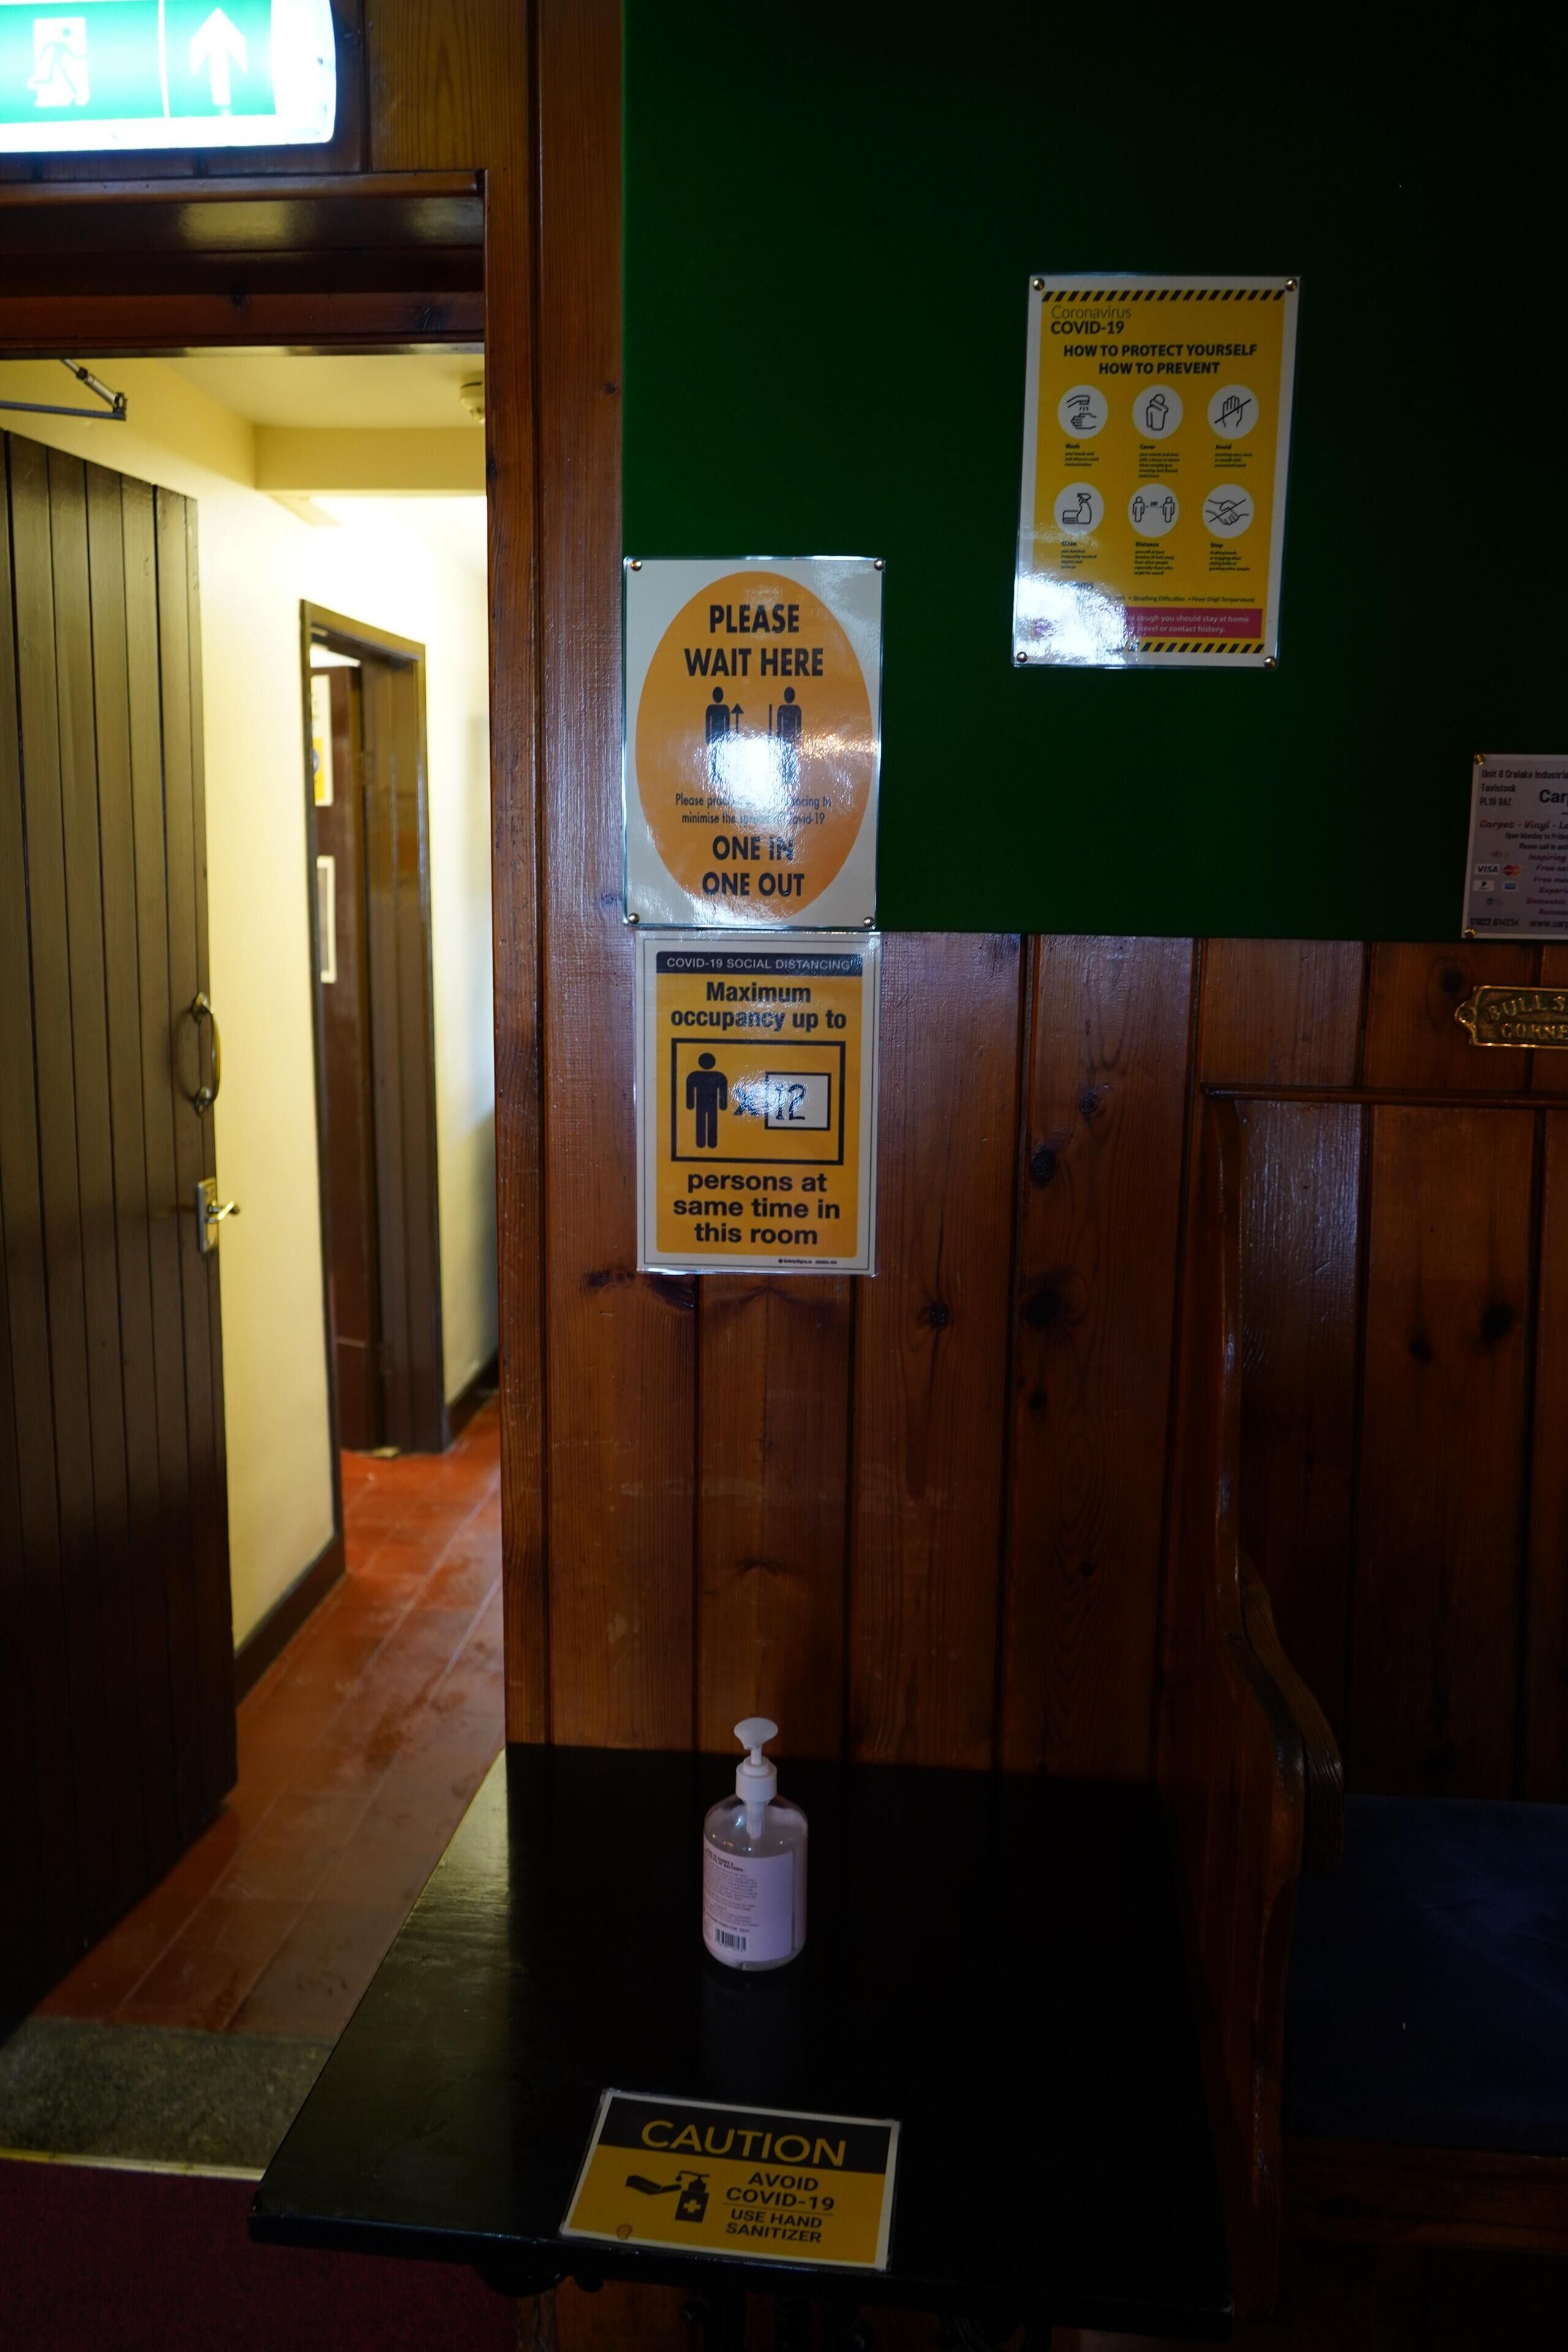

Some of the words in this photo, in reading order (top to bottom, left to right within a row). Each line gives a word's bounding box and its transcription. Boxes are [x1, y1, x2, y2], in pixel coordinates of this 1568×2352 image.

[1051, 306, 1131, 319] Coronavirus
[1050, 320, 1125, 335] COVID-19
[1063, 344, 1097, 358] HOW
[1100, 344, 1118, 357] TO
[1121, 344, 1184, 357] PROTECT
[1186, 343, 1257, 356] YOURSELF
[1098, 361, 1134, 375] HOW
[1136, 361, 1153, 374] TO
[1156, 361, 1220, 374] PREVENT
[710, 604, 799, 633] PLEASE
[1198, 625, 1225, 635] history.
[684, 648, 752, 677] WAIT
[761, 648, 823, 677] HERE
[1482, 769, 1496, 778] Unit
[1481, 783, 1516, 792] Tavistock
[676, 793, 704, 806] Please
[682, 812, 719, 824] minimise
[722, 811, 736, 824] the
[1480, 820, 1515, 831] Carpet
[1525, 820, 1550, 832] Vinyl
[712, 835, 760, 861] ONE
[769, 835, 794, 861] IN
[1529, 853, 1567, 863] Inspiring
[703, 872, 750, 897] ONE
[758, 872, 805, 897] OUT
[666, 957, 723, 968] COVID-19
[726, 958, 771, 970] SOCIAL
[775, 959, 850, 971] DISTANCING
[706, 981, 811, 1003] Maximum
[671, 1009, 785, 1031] occupancy
[793, 1012, 819, 1032] up
[826, 1009, 846, 1029] to
[774, 1084, 808, 1121] 12
[687, 1173, 793, 1193] persons
[801, 1174, 827, 1193] at
[673, 1199, 743, 1217] same
[752, 1197, 809, 1218] time
[818, 1199, 840, 1219] in
[694, 1223, 742, 1243] this
[750, 1227, 817, 1245] room
[641, 2120, 846, 2166] CAUTION
[748, 2171, 818, 2192] AVOID
[726, 2187, 835, 2211] COVID-19
[731, 2209, 766, 2225] USE
[771, 2212, 822, 2229] HAND
[726, 2223, 822, 2244] SANITIZER
